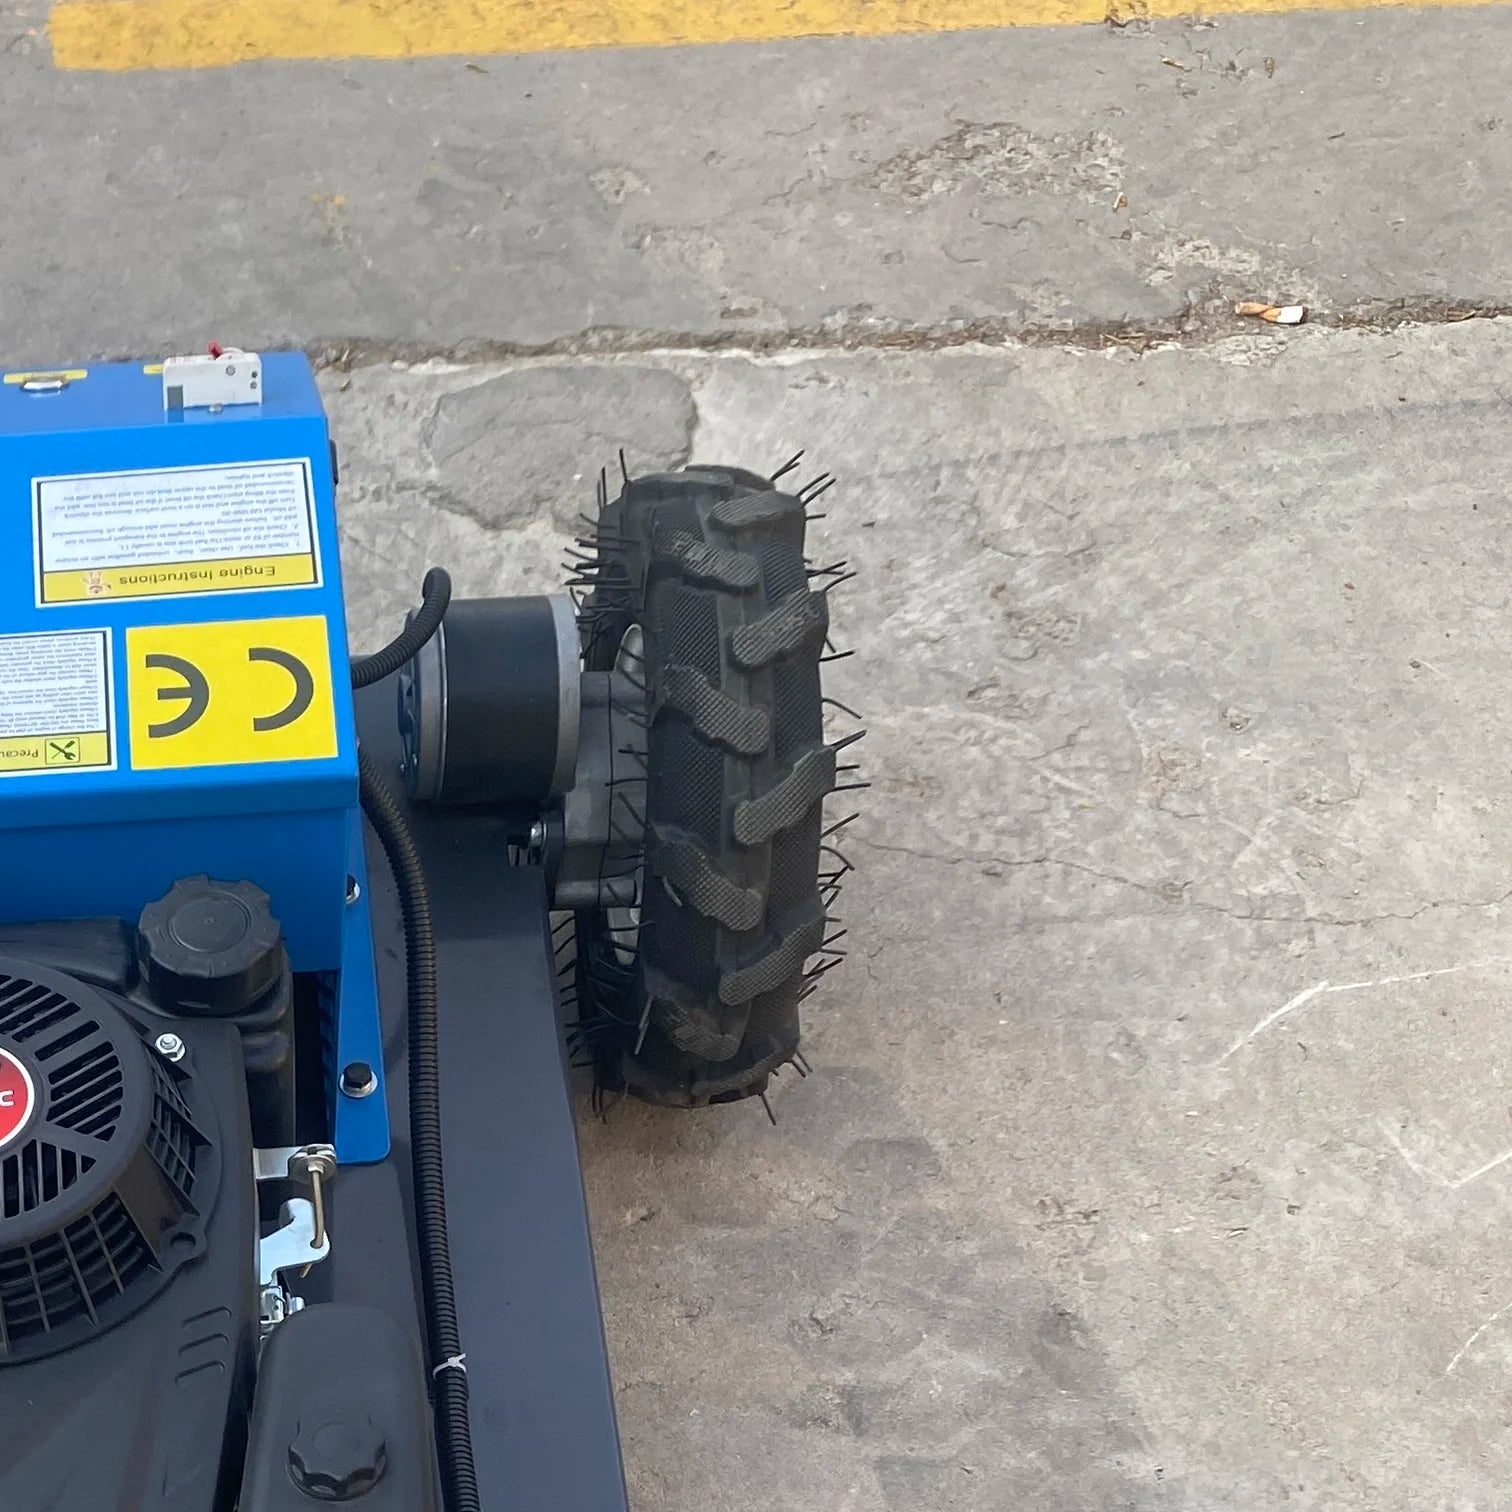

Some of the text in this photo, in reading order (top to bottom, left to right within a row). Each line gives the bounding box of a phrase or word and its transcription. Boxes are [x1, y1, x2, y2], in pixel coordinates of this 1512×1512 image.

[119, 565, 275, 585] Engine Instructions
[145, 647, 314, 738] CE
